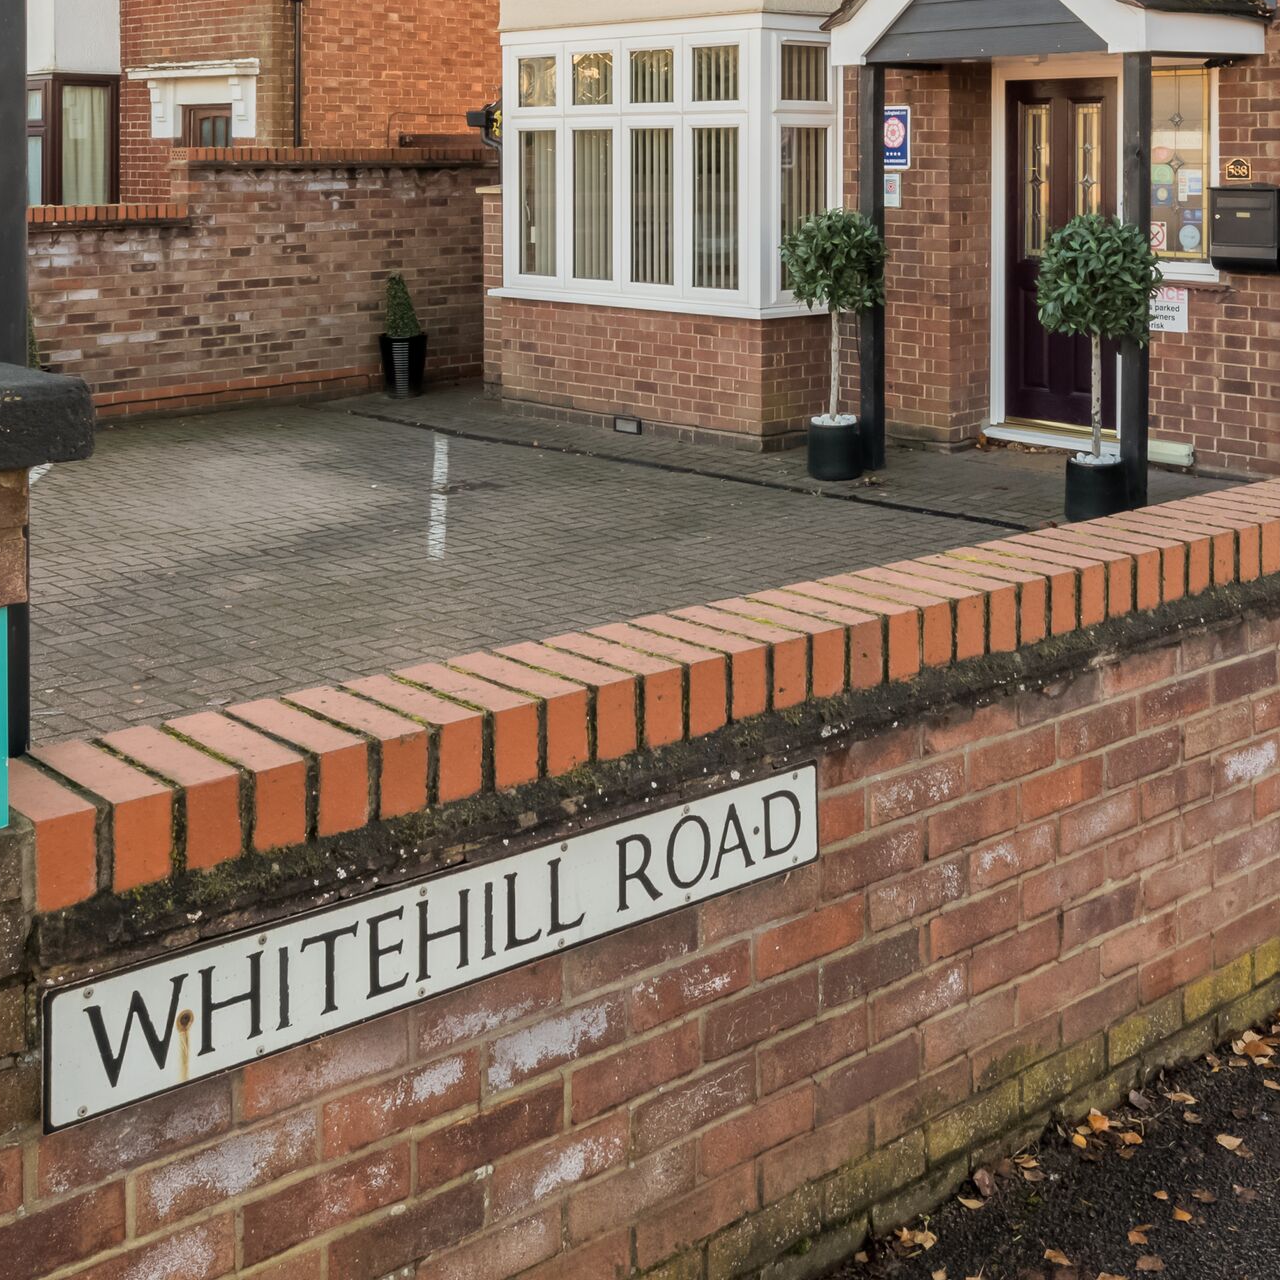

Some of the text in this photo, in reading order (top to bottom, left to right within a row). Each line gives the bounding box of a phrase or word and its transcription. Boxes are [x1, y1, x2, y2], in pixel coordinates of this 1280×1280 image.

[1228, 164, 1248, 177] 588
[1155, 304, 1180, 312] parked
[82, 789, 803, 1089] WHITEHILL ROAD
